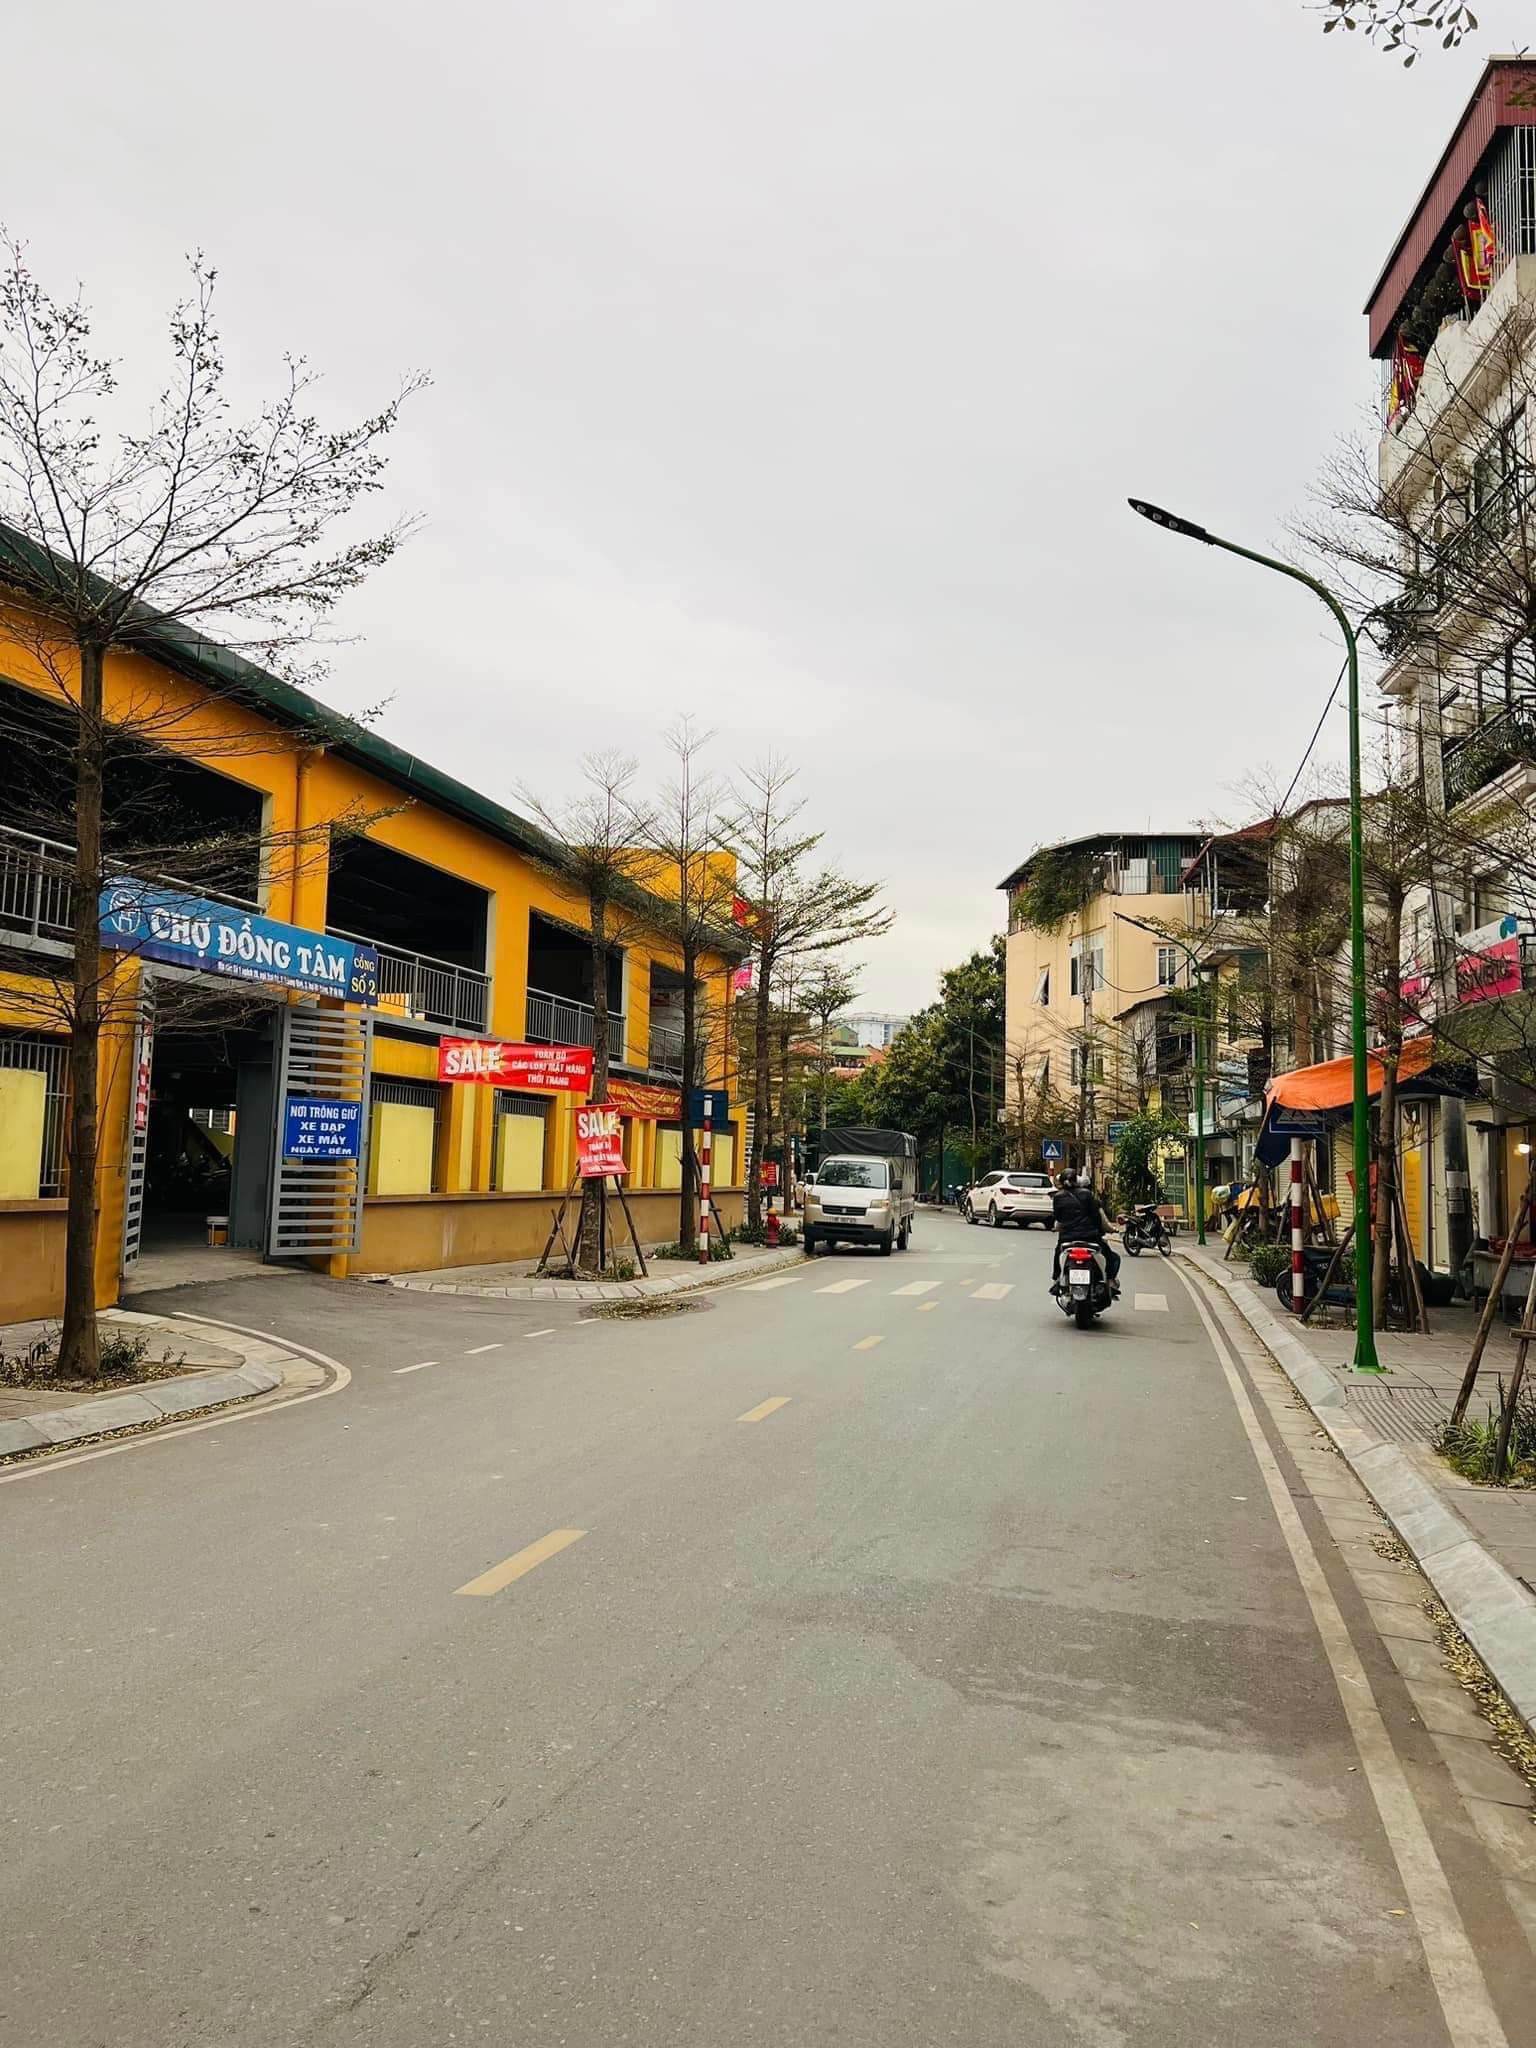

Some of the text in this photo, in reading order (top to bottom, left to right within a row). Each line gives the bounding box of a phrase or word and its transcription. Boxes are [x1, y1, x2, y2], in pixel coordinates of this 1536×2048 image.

[150, 907, 211, 958] CHỢ
[218, 917, 291, 969] ĐỒNG
[296, 943, 345, 982] TÂM
[353, 953, 375, 972] CỔNG
[351, 973, 366, 994] SỐ
[368, 979, 377, 997] 2
[445, 1046, 500, 1075] SALE
[290, 1105, 307, 1118] NƠI
[341, 1106, 358, 1120] GIỮ
[300, 1121, 346, 1134] XE ĐẠP
[578, 1111, 617, 1138] SALE
[298, 1134, 346, 1145] XE MÁY
